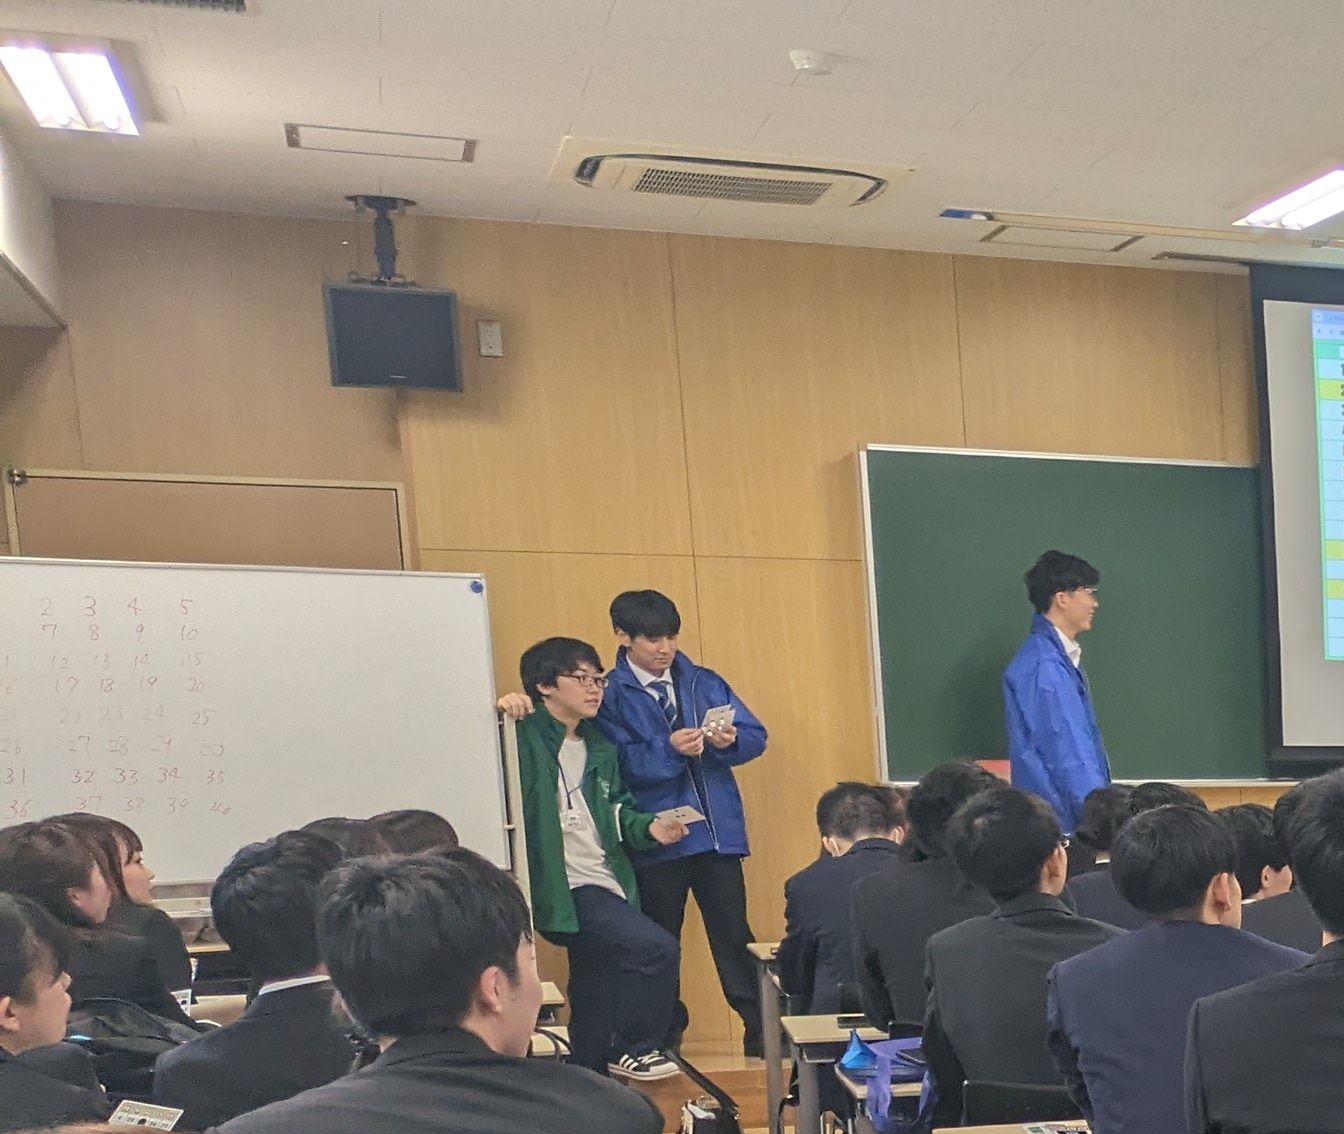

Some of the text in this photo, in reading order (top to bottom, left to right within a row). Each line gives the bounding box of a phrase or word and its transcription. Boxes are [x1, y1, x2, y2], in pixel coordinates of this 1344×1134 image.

[84, 595, 97, 617] 3
[128, 597, 142, 616] 4
[181, 597, 193, 615] 5
[42, 624, 57, 640] 7
[89, 624, 100, 640] 8
[55, 676, 80, 693] 17
[100, 678, 115, 693] 18
[3, 767, 26, 786] 31
[72, 769, 94, 784] 32
[112, 767, 138, 785] 33
[158, 767, 181, 783] 34
[4, 799, 32, 820] 36
